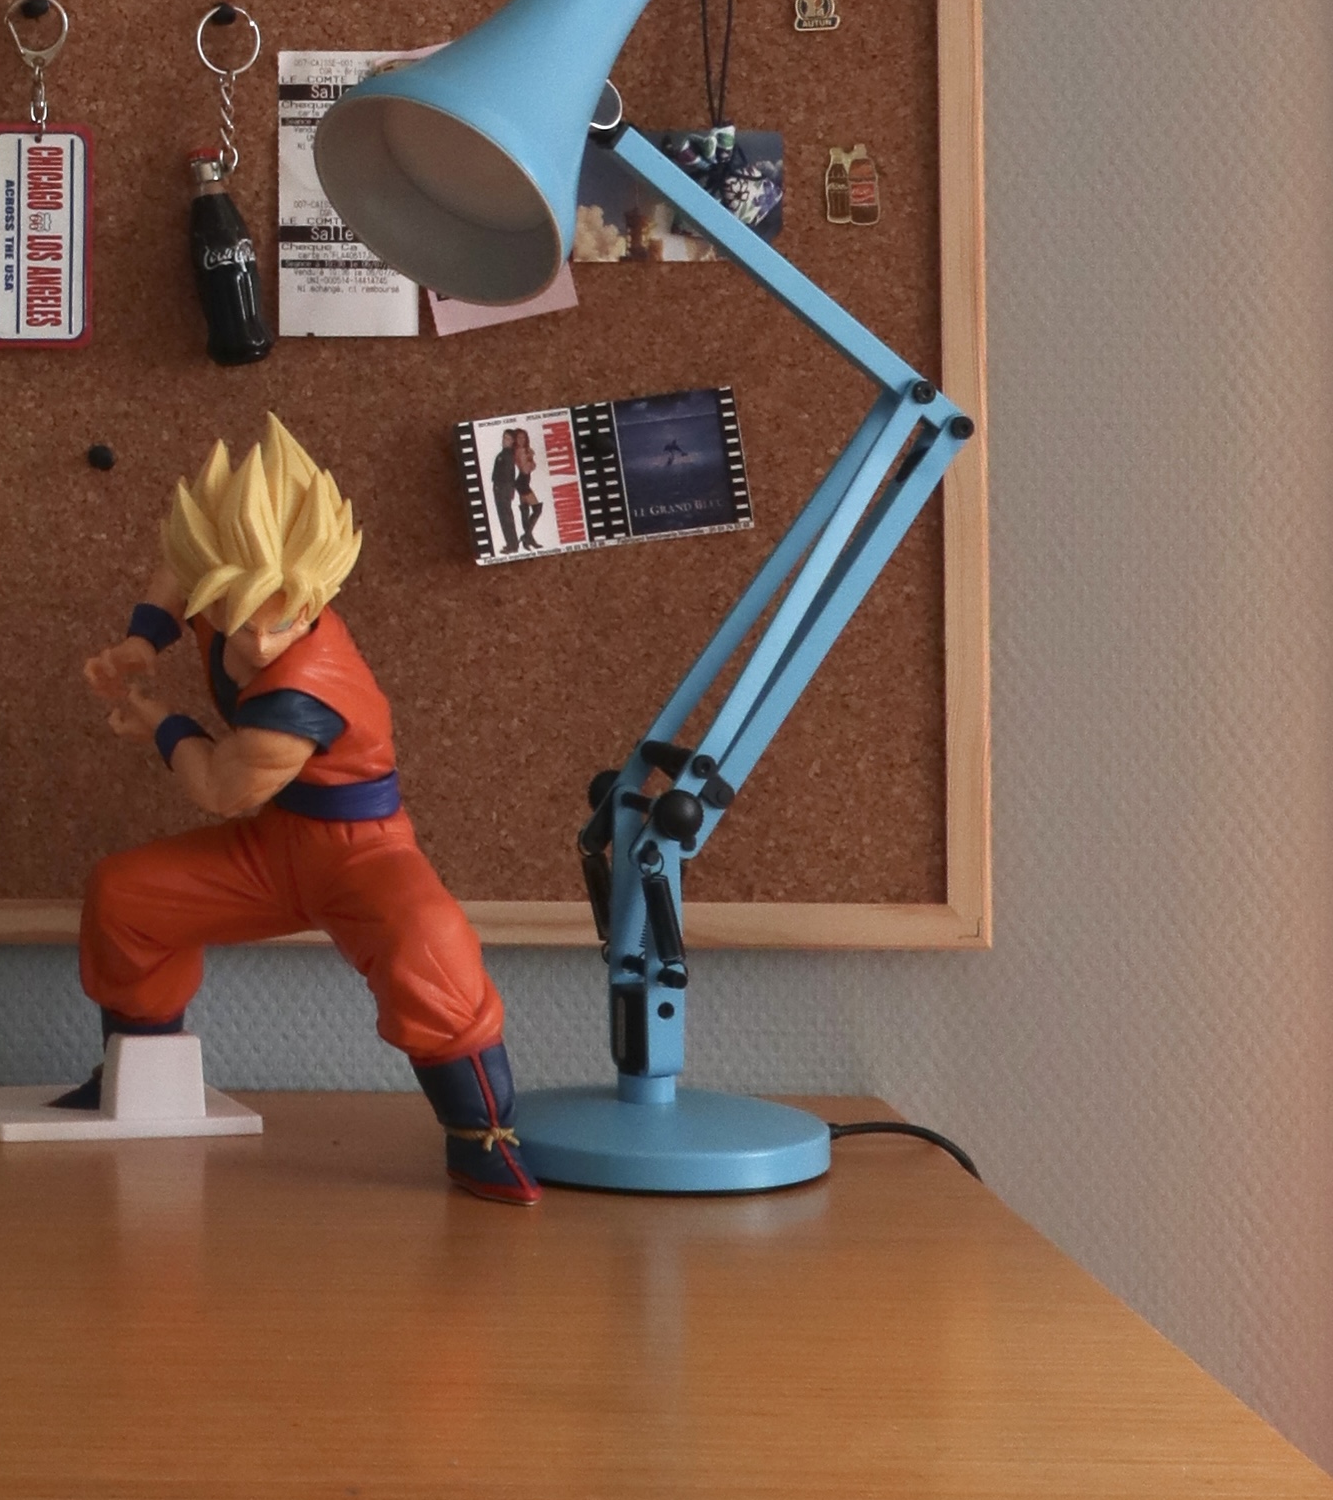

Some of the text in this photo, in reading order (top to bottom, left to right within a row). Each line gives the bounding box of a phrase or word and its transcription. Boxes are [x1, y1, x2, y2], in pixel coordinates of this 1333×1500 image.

[802, 18, 832, 27] AUTUN
[307, 75, 345, 83] COMTE
[26, 146, 64, 210] CHICAGO
[4, 179, 15, 291] ACROSS THE USA
[281, 217, 297, 225] LE
[311, 226, 354, 241] Salle
[25, 234, 63, 327] LOS ANGELES
[542, 421, 577, 476] PRETTY
[551, 481, 587, 545] WOMAN
[649, 502, 692, 516] GRAND
